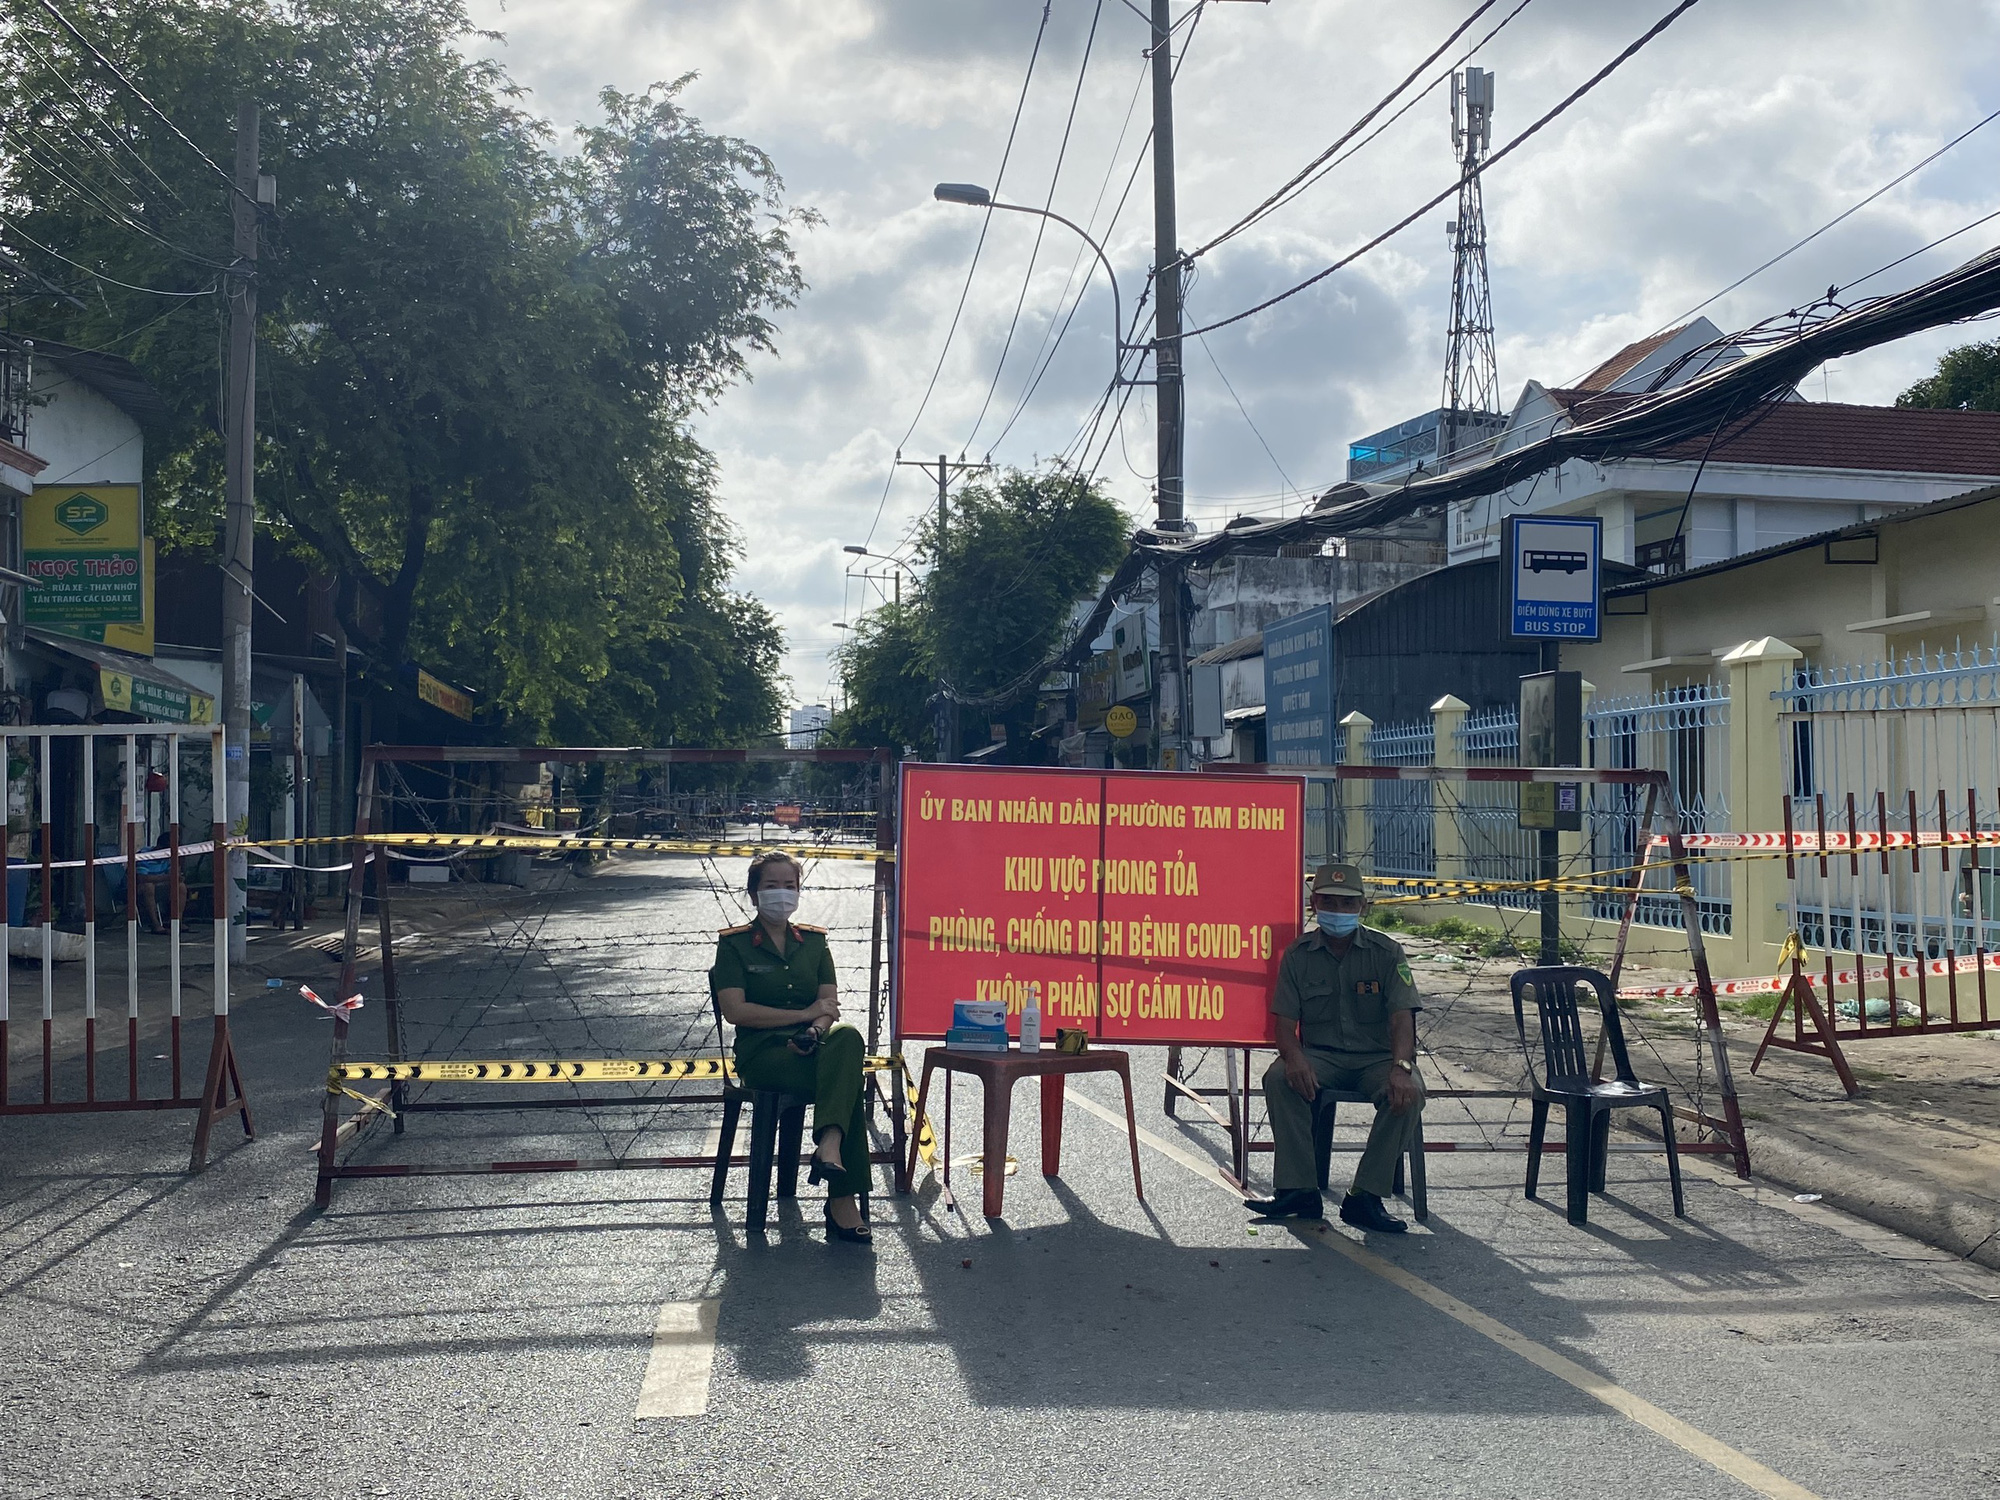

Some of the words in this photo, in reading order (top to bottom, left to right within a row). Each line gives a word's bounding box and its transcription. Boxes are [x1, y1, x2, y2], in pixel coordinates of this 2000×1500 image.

[66, 506, 96, 518] SP
[27, 559, 79, 580] NGỌC
[83, 554, 138, 578] THẢO
[52, 582, 71, 592] RỬA
[72, 584, 83, 592] XE
[90, 584, 114, 592] THAY
[52, 595, 81, 603] TRANG
[84, 594, 100, 602] CÁC
[102, 595, 120, 604] LOẠI
[1562, 607, 1572, 618] XE
[1574, 606, 1593, 618] BUÝT
[1524, 621, 1550, 632] BUS
[1554, 622, 1586, 633] STOP
[1110, 712, 1134, 722] GẠO
[920, 790, 946, 821] ỦY
[952, 799, 992, 822] BAN
[998, 796, 1054, 824] NHÂN
[1060, 798, 1100, 827] DÂN
[1106, 798, 1186, 829] PHƯỜNG
[1191, 806, 1232, 829] TAM
[1238, 803, 1285, 831] BÌNH
[1004, 856, 1043, 893] KHU
[1050, 855, 1086, 901] VỰC
[1092, 859, 1157, 896] PHONG
[1162, 850, 1199, 897] TỎA
[930, 908, 1000, 957] PHÒNG,
[1006, 906, 1072, 955] CHỐNG
[1078, 920, 1123, 963] DỊCH
[1128, 914, 1180, 965] BỆNH
[1186, 922, 1272, 960] COVID-19
[1048, 974, 1099, 1025] PHẬN
[1106, 980, 1134, 1026] SỰ
[1138, 972, 1182, 1020] CẤM
[1188, 977, 1224, 1021] VÀO
